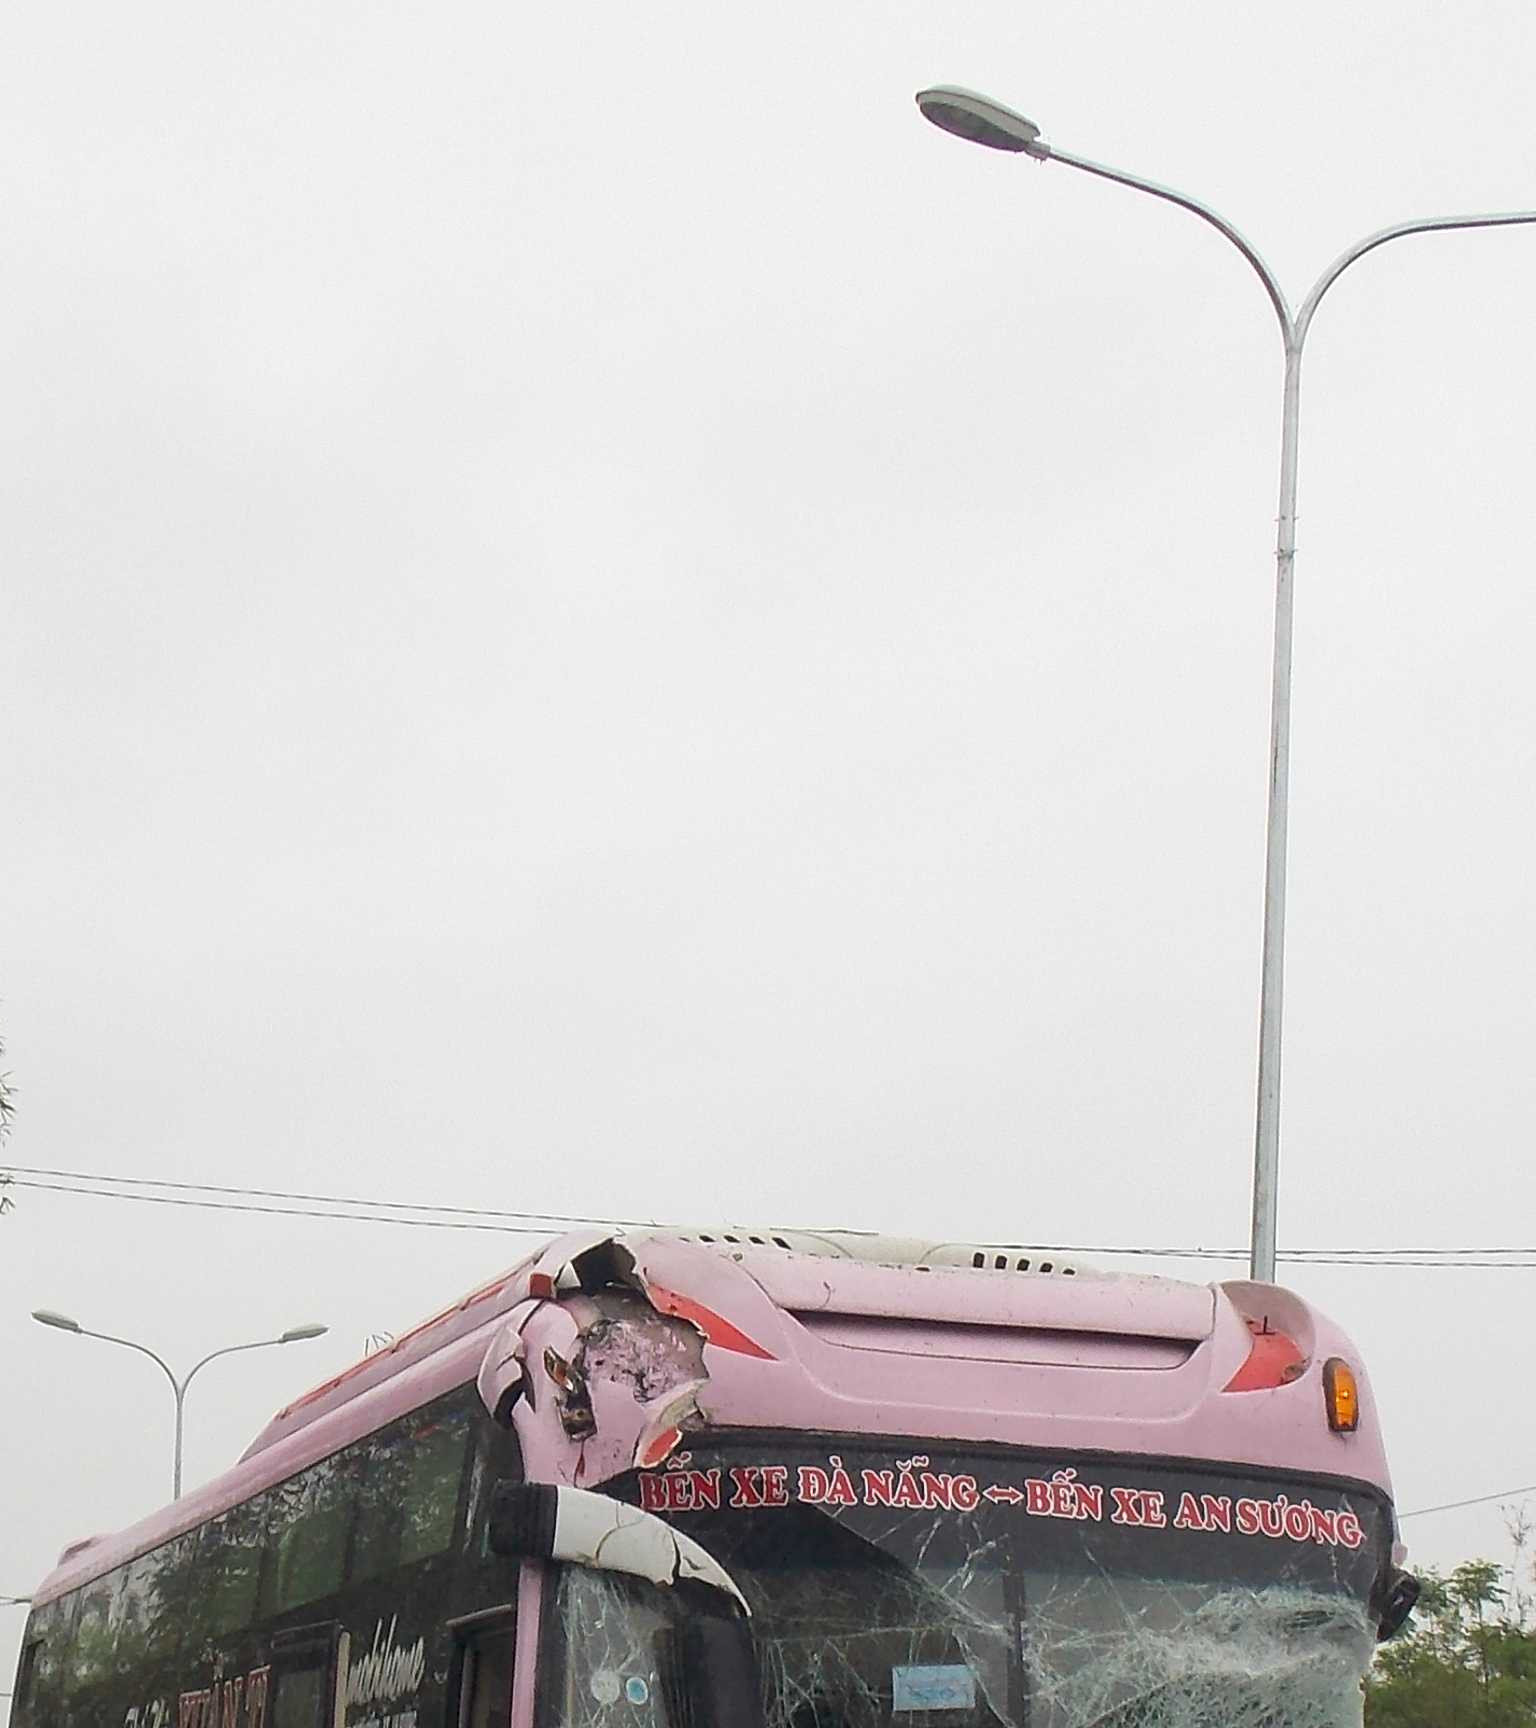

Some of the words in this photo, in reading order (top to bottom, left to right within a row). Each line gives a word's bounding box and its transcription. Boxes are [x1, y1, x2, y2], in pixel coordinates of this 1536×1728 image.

[639, 1451, 720, 1512] BẾN
[729, 1466, 788, 1507] XE
[798, 1455, 857, 1506] ĐÀ
[862, 1456, 980, 1511] NẴNG
[1025, 1468, 1103, 1521] BẾN
[1111, 1487, 1167, 1528] XE
[1174, 1492, 1232, 1533] AN
[1235, 1495, 1364, 1548] SƯƠNG
